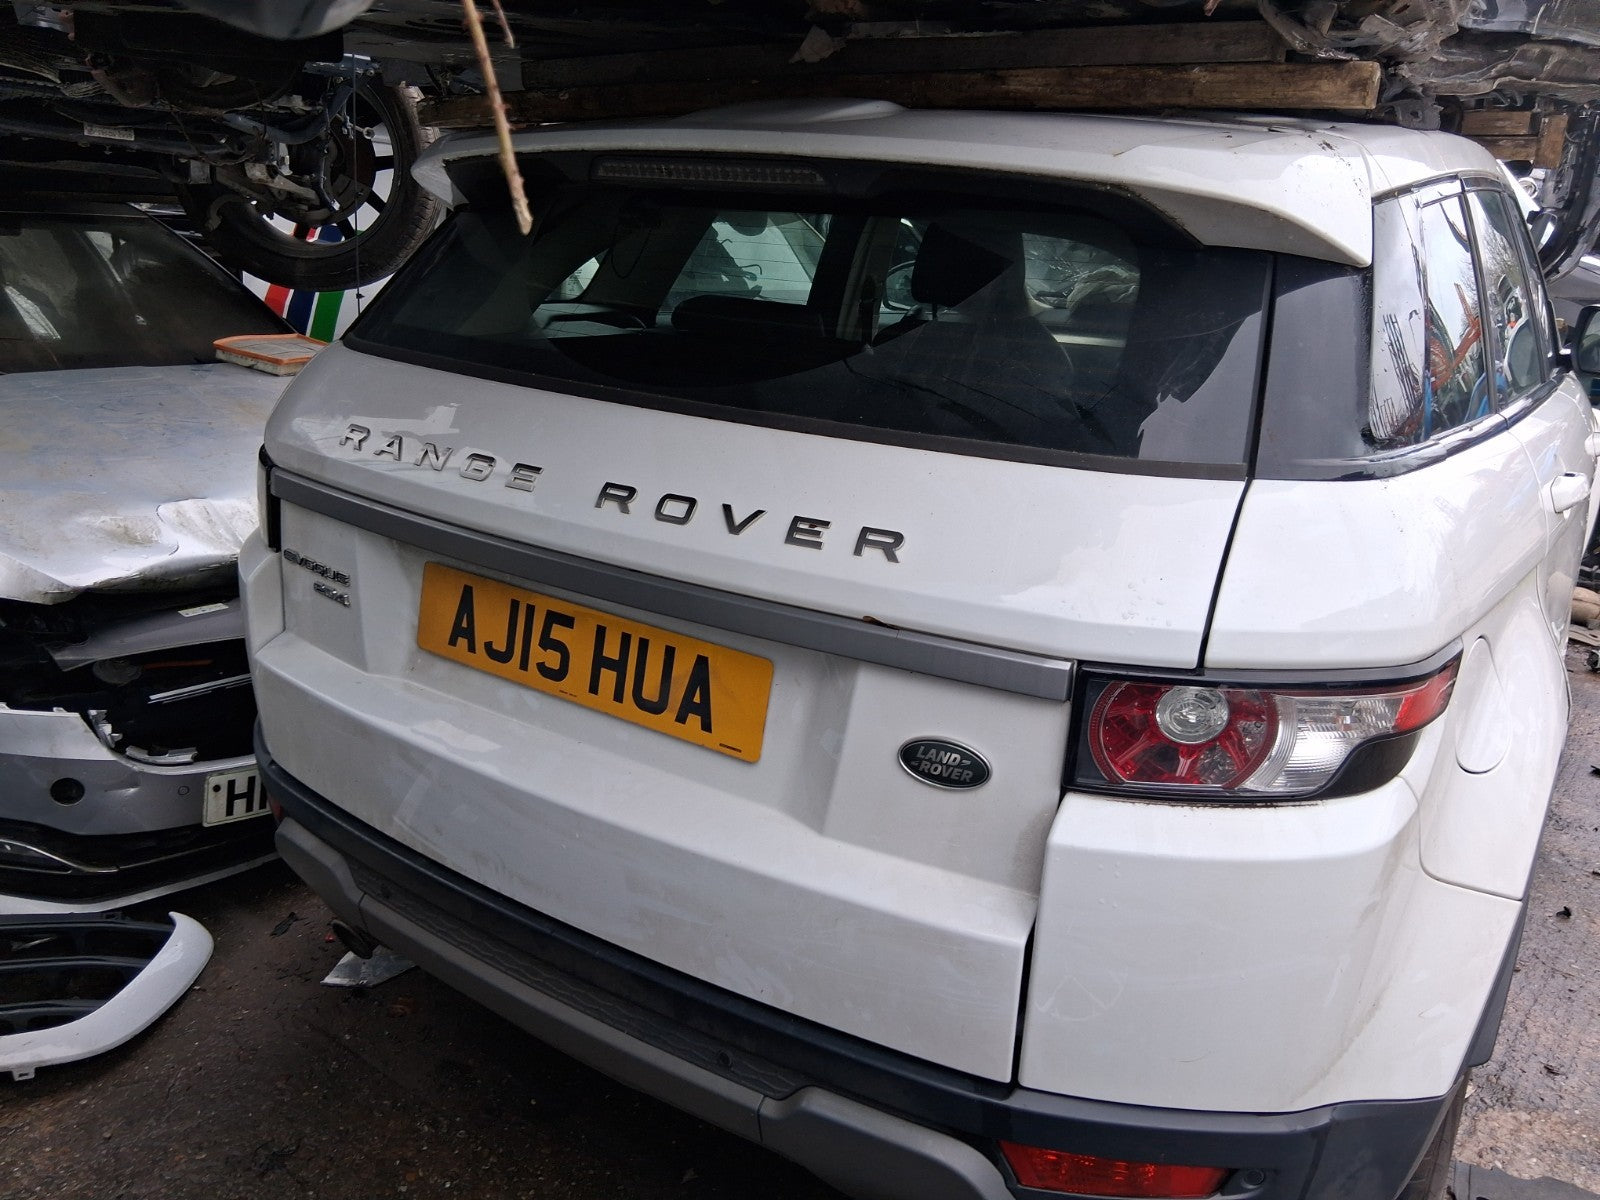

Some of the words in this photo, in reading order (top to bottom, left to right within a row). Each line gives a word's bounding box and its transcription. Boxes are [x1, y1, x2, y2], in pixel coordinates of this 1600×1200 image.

[339, 423, 545, 493] RANGE
[594, 481, 905, 564] ROVER
[447, 583, 575, 683] AJ15
[588, 624, 713, 734] HUA
[917, 745, 961, 766] LAND
[919, 760, 974, 783] ROVER
